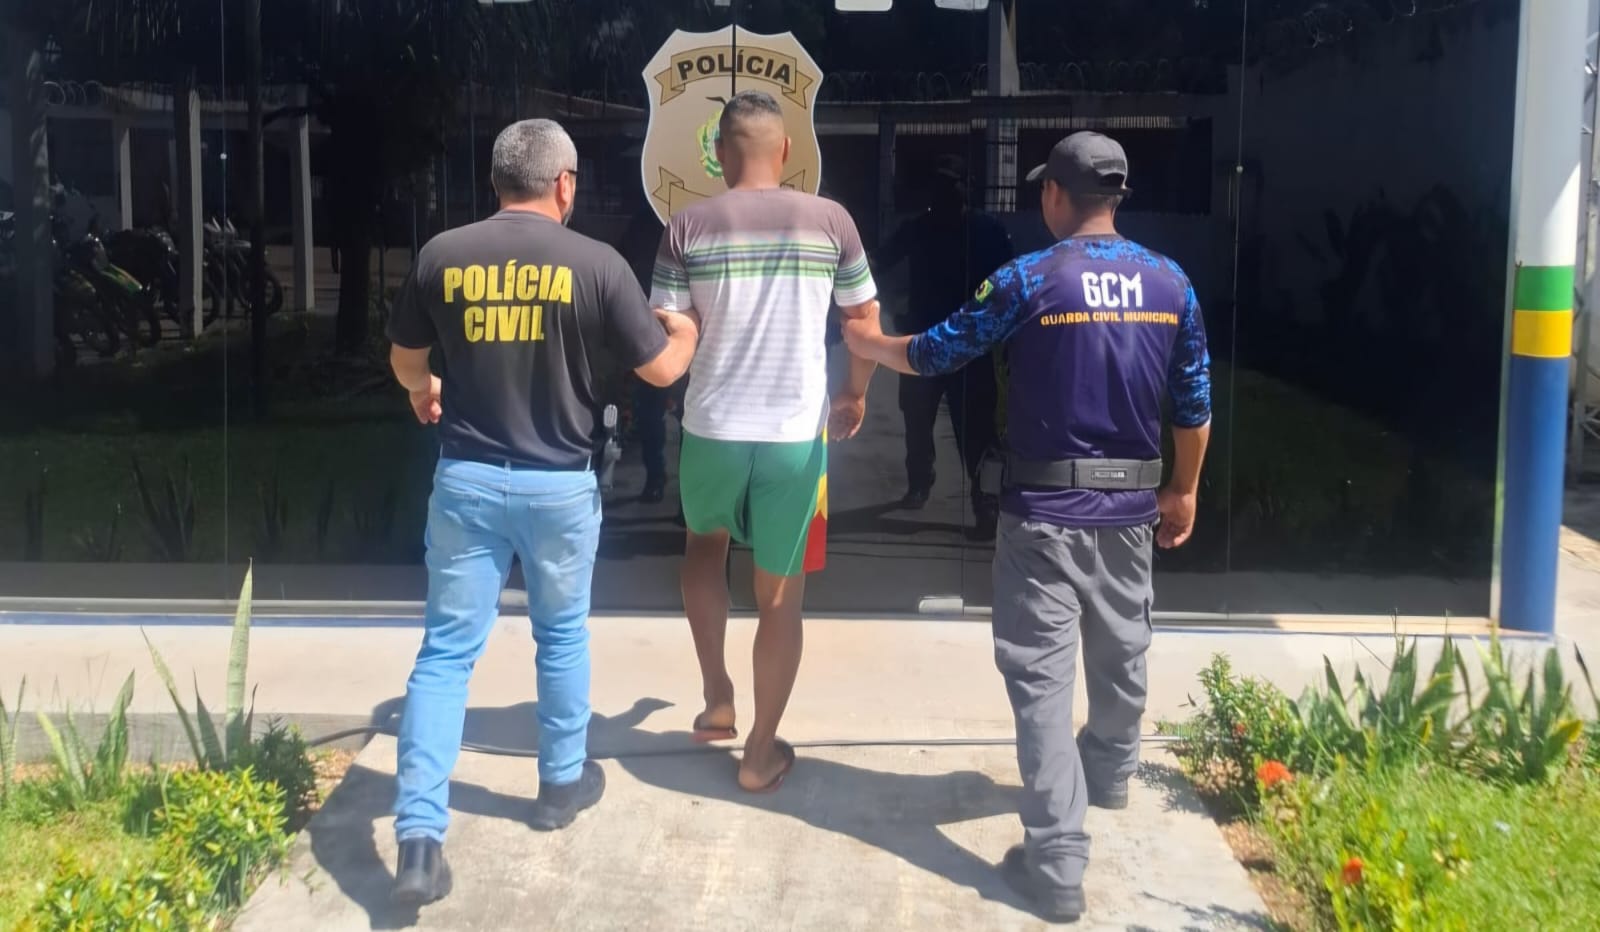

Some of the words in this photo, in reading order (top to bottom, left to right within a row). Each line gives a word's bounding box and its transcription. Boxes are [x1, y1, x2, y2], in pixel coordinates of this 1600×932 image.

[677, 49, 791, 85] POLÍCIA
[443, 259, 573, 304] POLÍCIA
[1081, 271, 1143, 308] GCM
[464, 305, 545, 343] CIVIL
[1040, 311, 1090, 326] GUARDA
[1092, 311, 1121, 323] CIVIL
